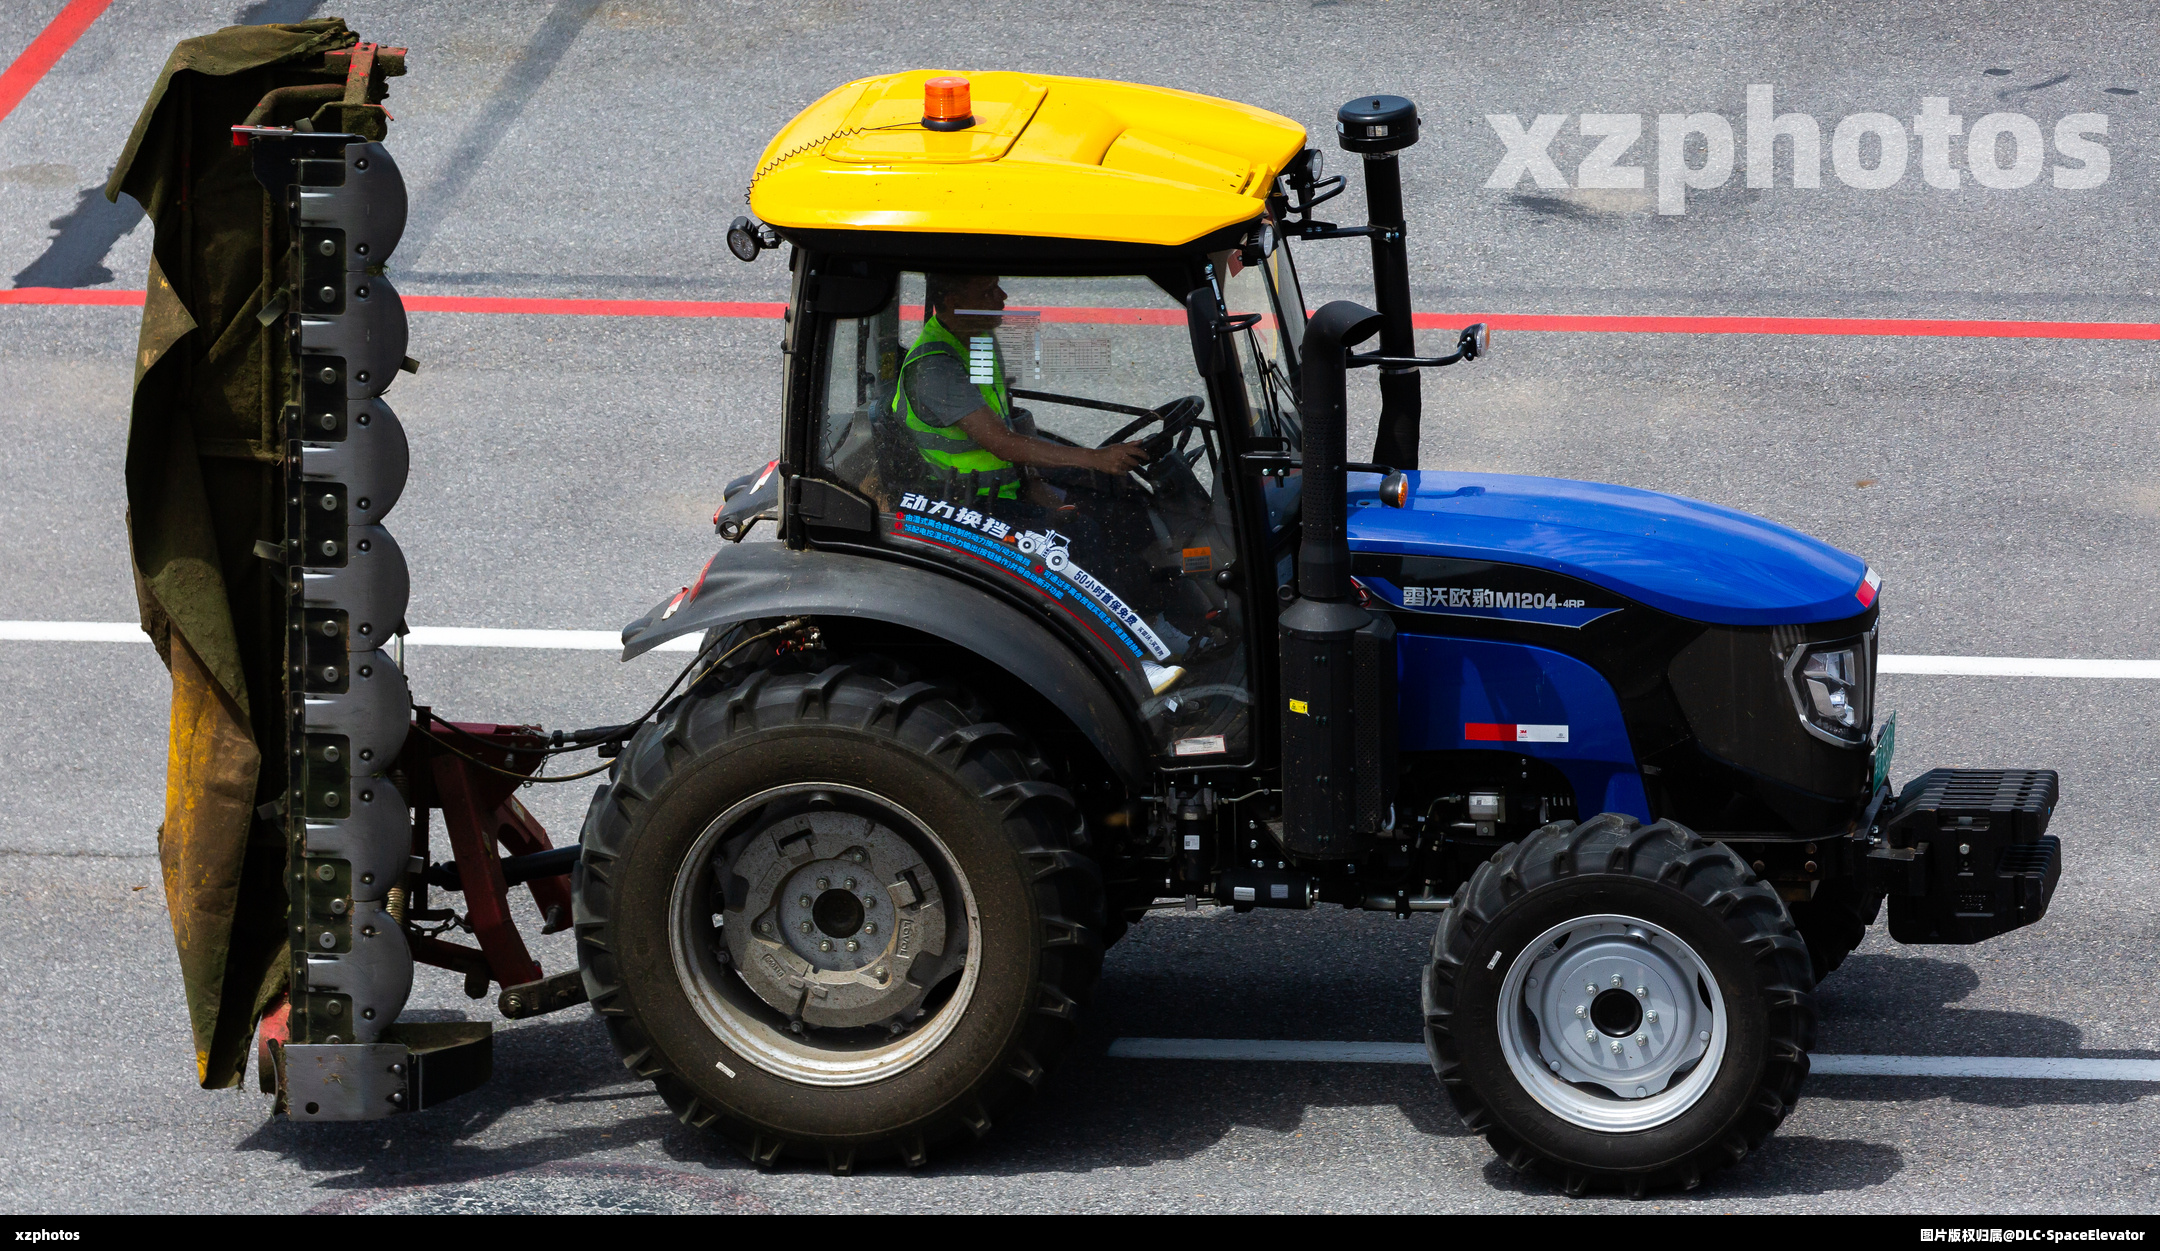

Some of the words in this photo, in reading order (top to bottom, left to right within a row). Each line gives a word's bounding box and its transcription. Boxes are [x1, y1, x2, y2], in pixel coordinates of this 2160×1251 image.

[899, 492, 1011, 540] 动力换挡
[1073, 570, 1138, 627] 50小时首保免费
[900, 920, 911, 955] LOVOL
